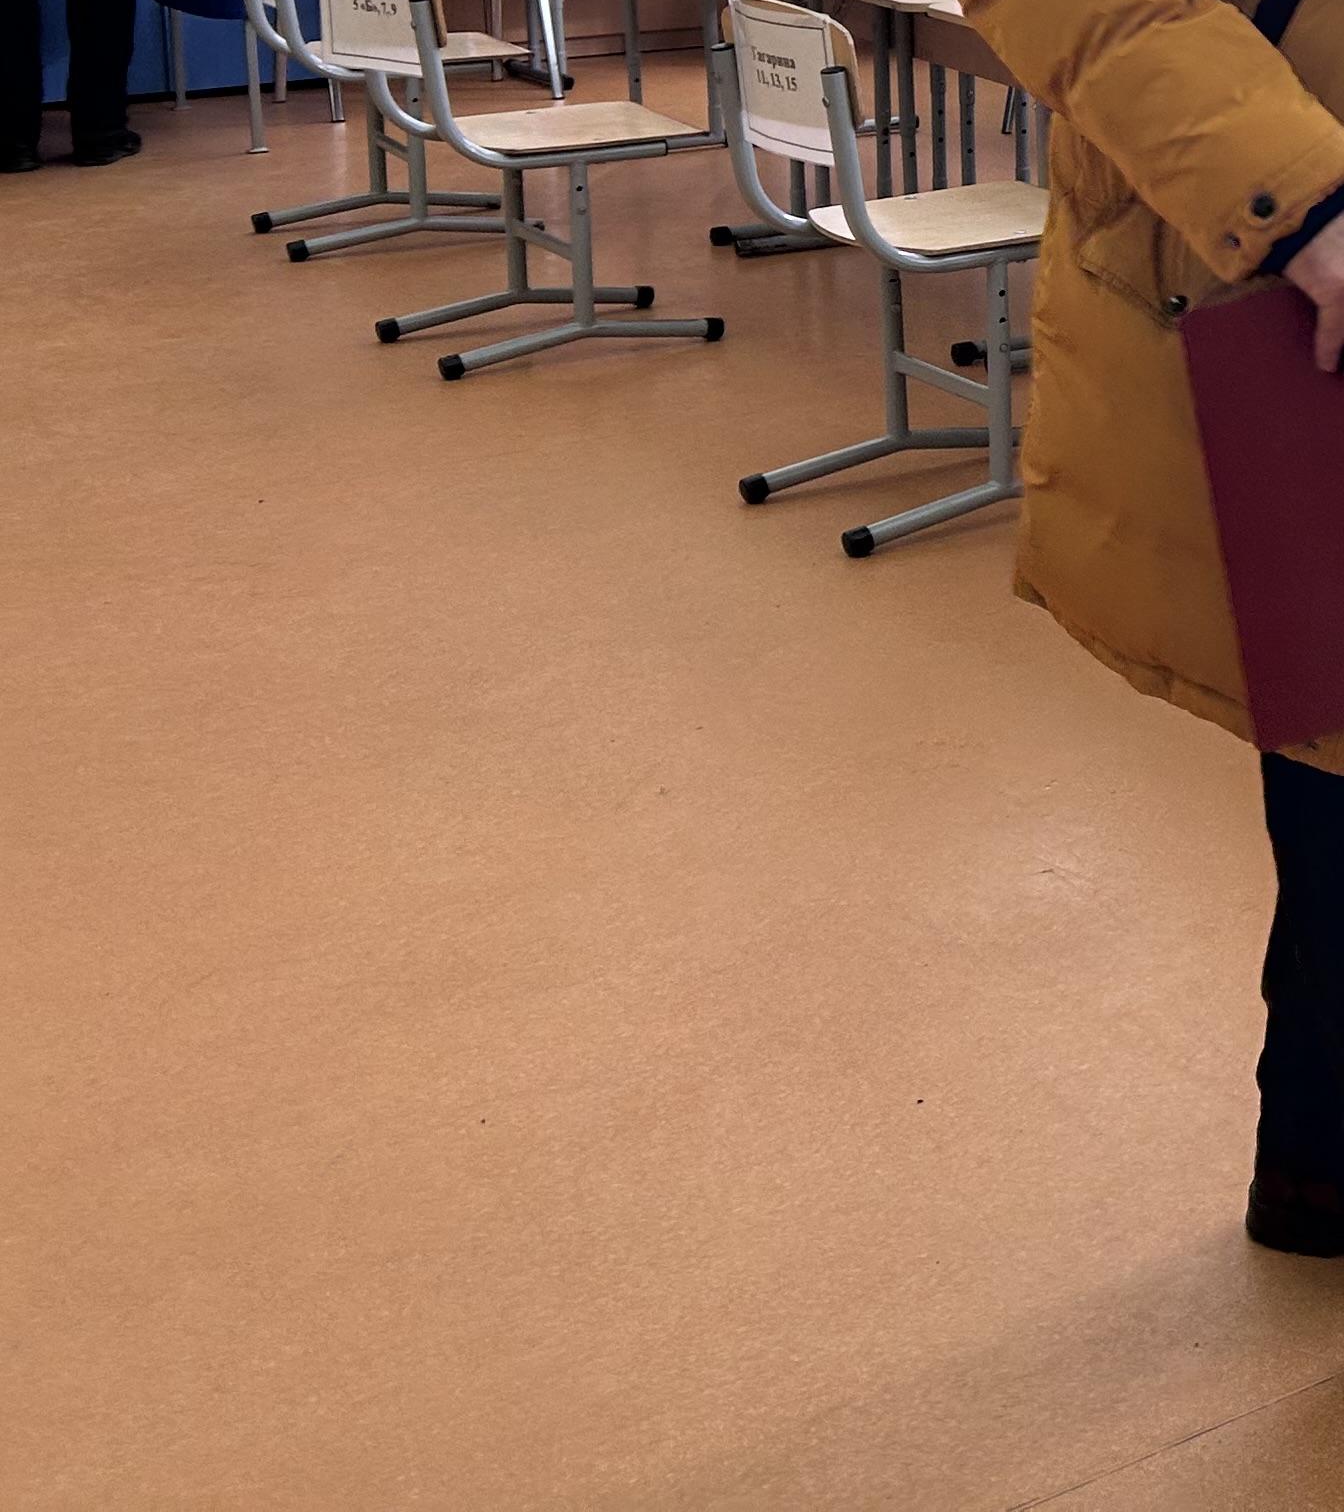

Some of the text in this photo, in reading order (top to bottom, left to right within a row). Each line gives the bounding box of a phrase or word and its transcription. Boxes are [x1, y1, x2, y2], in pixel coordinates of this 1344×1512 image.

[353, 0, 359, 11] 5
[751, 45, 796, 69] Гагарина
[785, 76, 798, 92] 15
